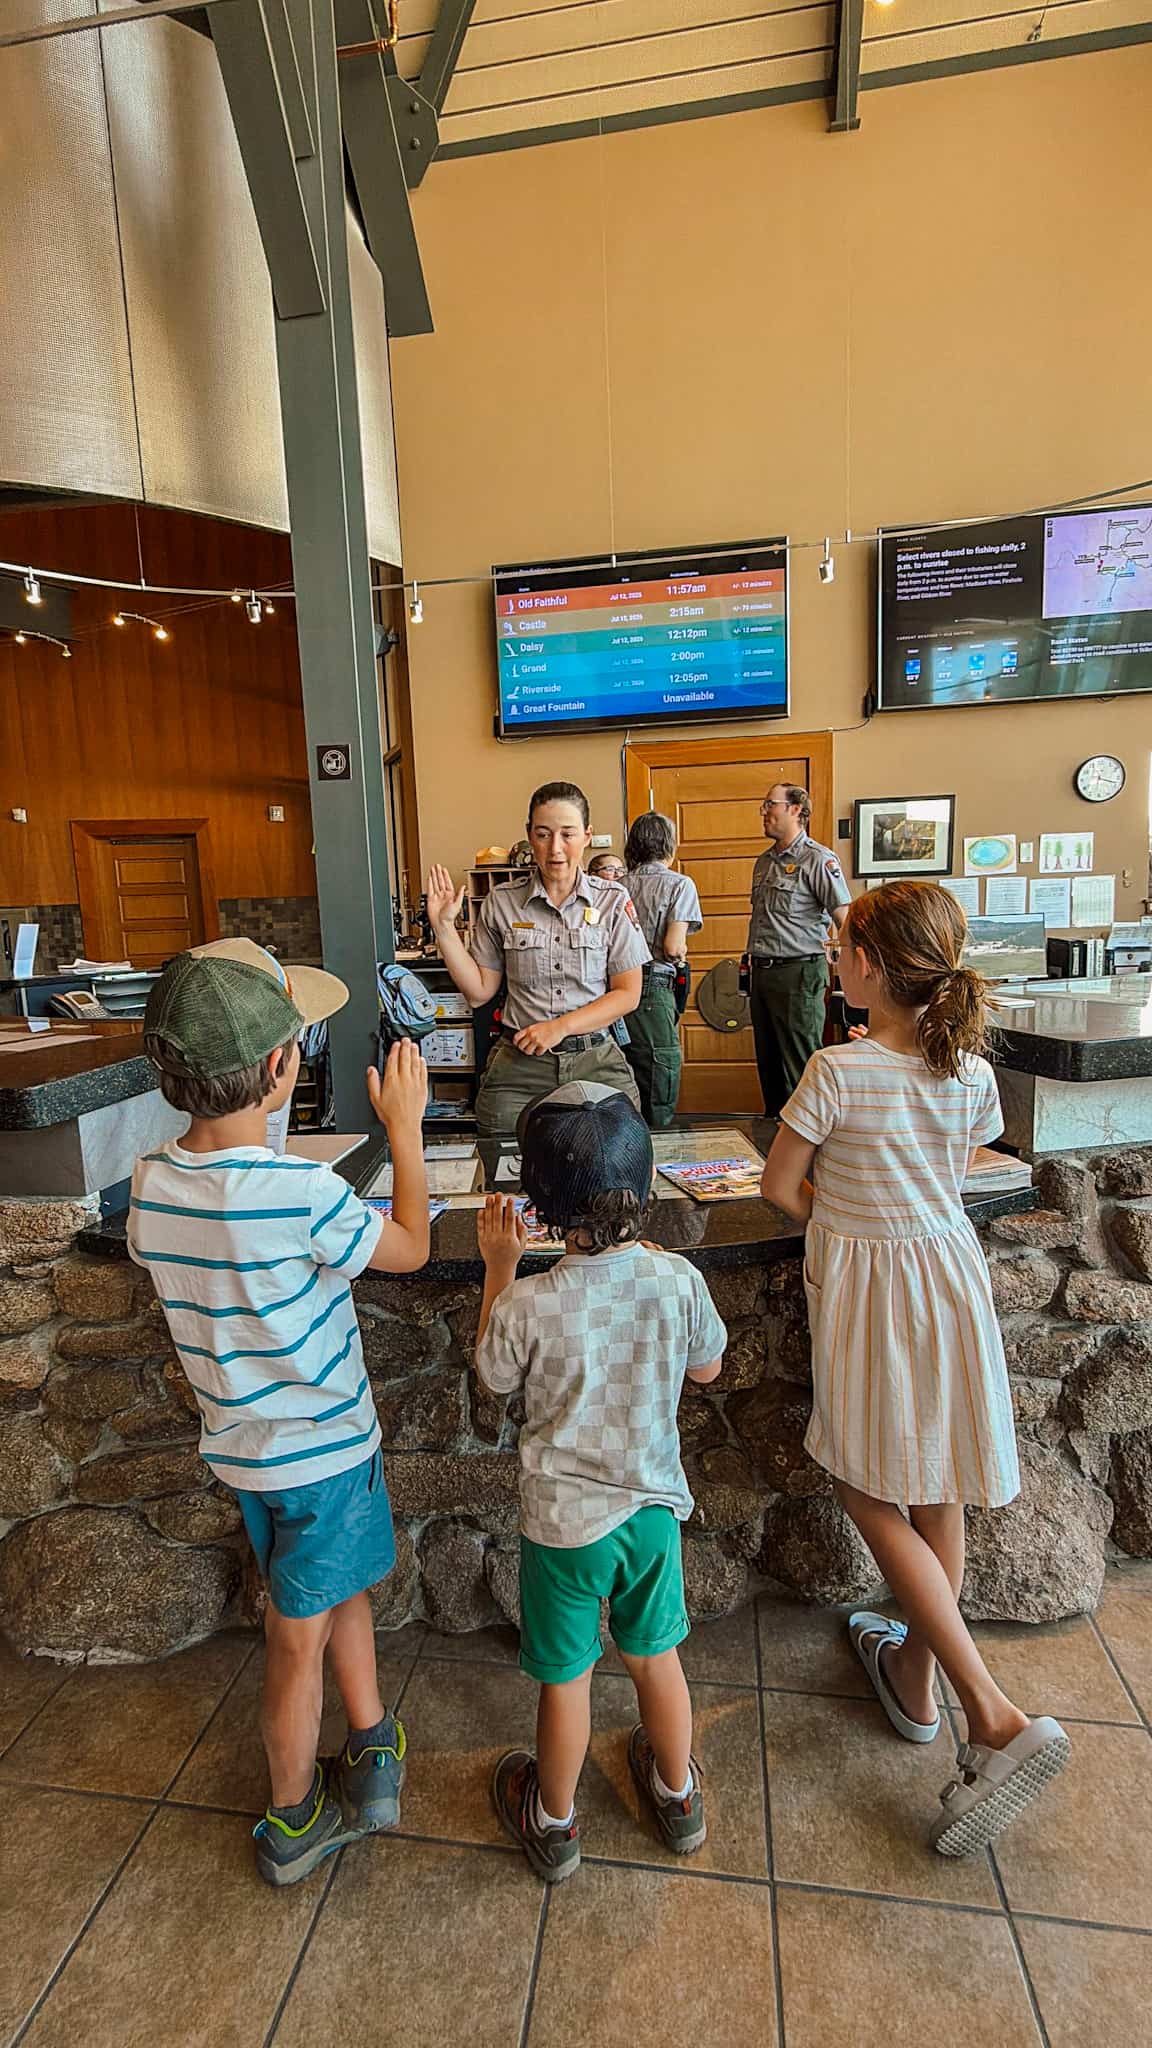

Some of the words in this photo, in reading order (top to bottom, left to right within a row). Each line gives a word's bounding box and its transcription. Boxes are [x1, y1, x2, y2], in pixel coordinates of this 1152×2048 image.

[897, 554, 919, 562] Select
[920, 552, 940, 560] rivers
[942, 549, 965, 558] closed
[975, 545, 1000, 554] fishing
[1020, 542, 1026, 550] 2
[914, 561, 922, 569] to
[518, 600, 532, 609] Old
[535, 596, 568, 608] Faithful
[667, 584, 706, 596] 11:57am
[520, 620, 546, 630] Castle
[670, 606, 704, 617] 2:15am
[521, 642, 544, 652] Daisy
[668, 629, 708, 640] 12:12pm
[522, 664, 546, 673] Grand
[671, 651, 704, 661] 2:00pm
[522, 684, 561, 694] Riverside
[670, 672, 708, 683] 12:05pm
[524, 704, 546, 714] Great
[548, 701, 584, 712] Fountain
[663, 691, 714, 703] Unavailable
